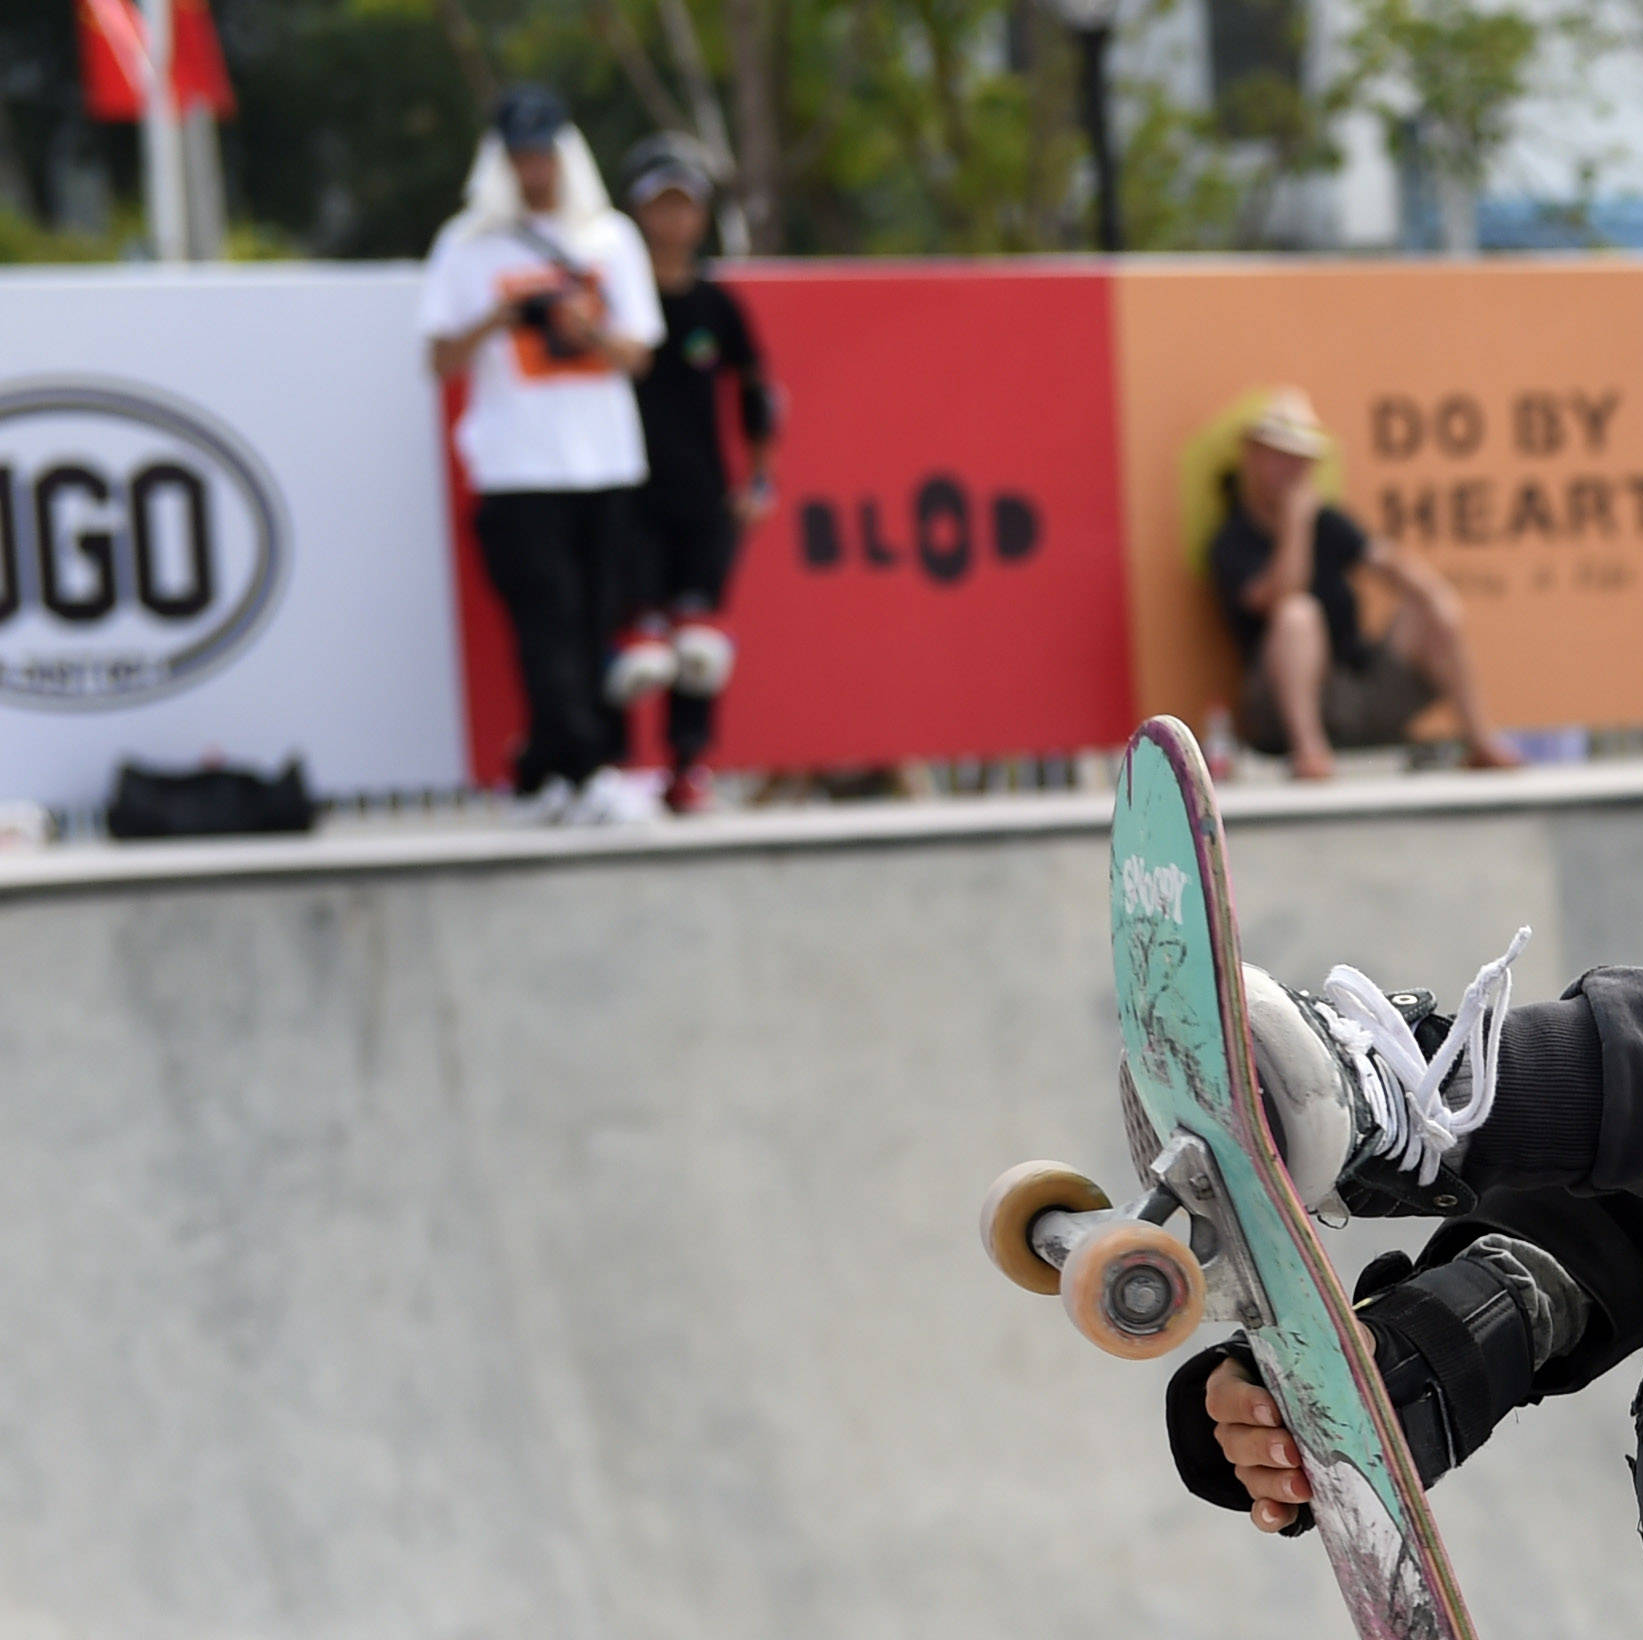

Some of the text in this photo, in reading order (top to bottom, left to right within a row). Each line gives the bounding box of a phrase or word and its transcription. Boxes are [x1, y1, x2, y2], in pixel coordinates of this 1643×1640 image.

[1368, 385, 1624, 463] DO BY
[0, 458, 214, 632] GO
